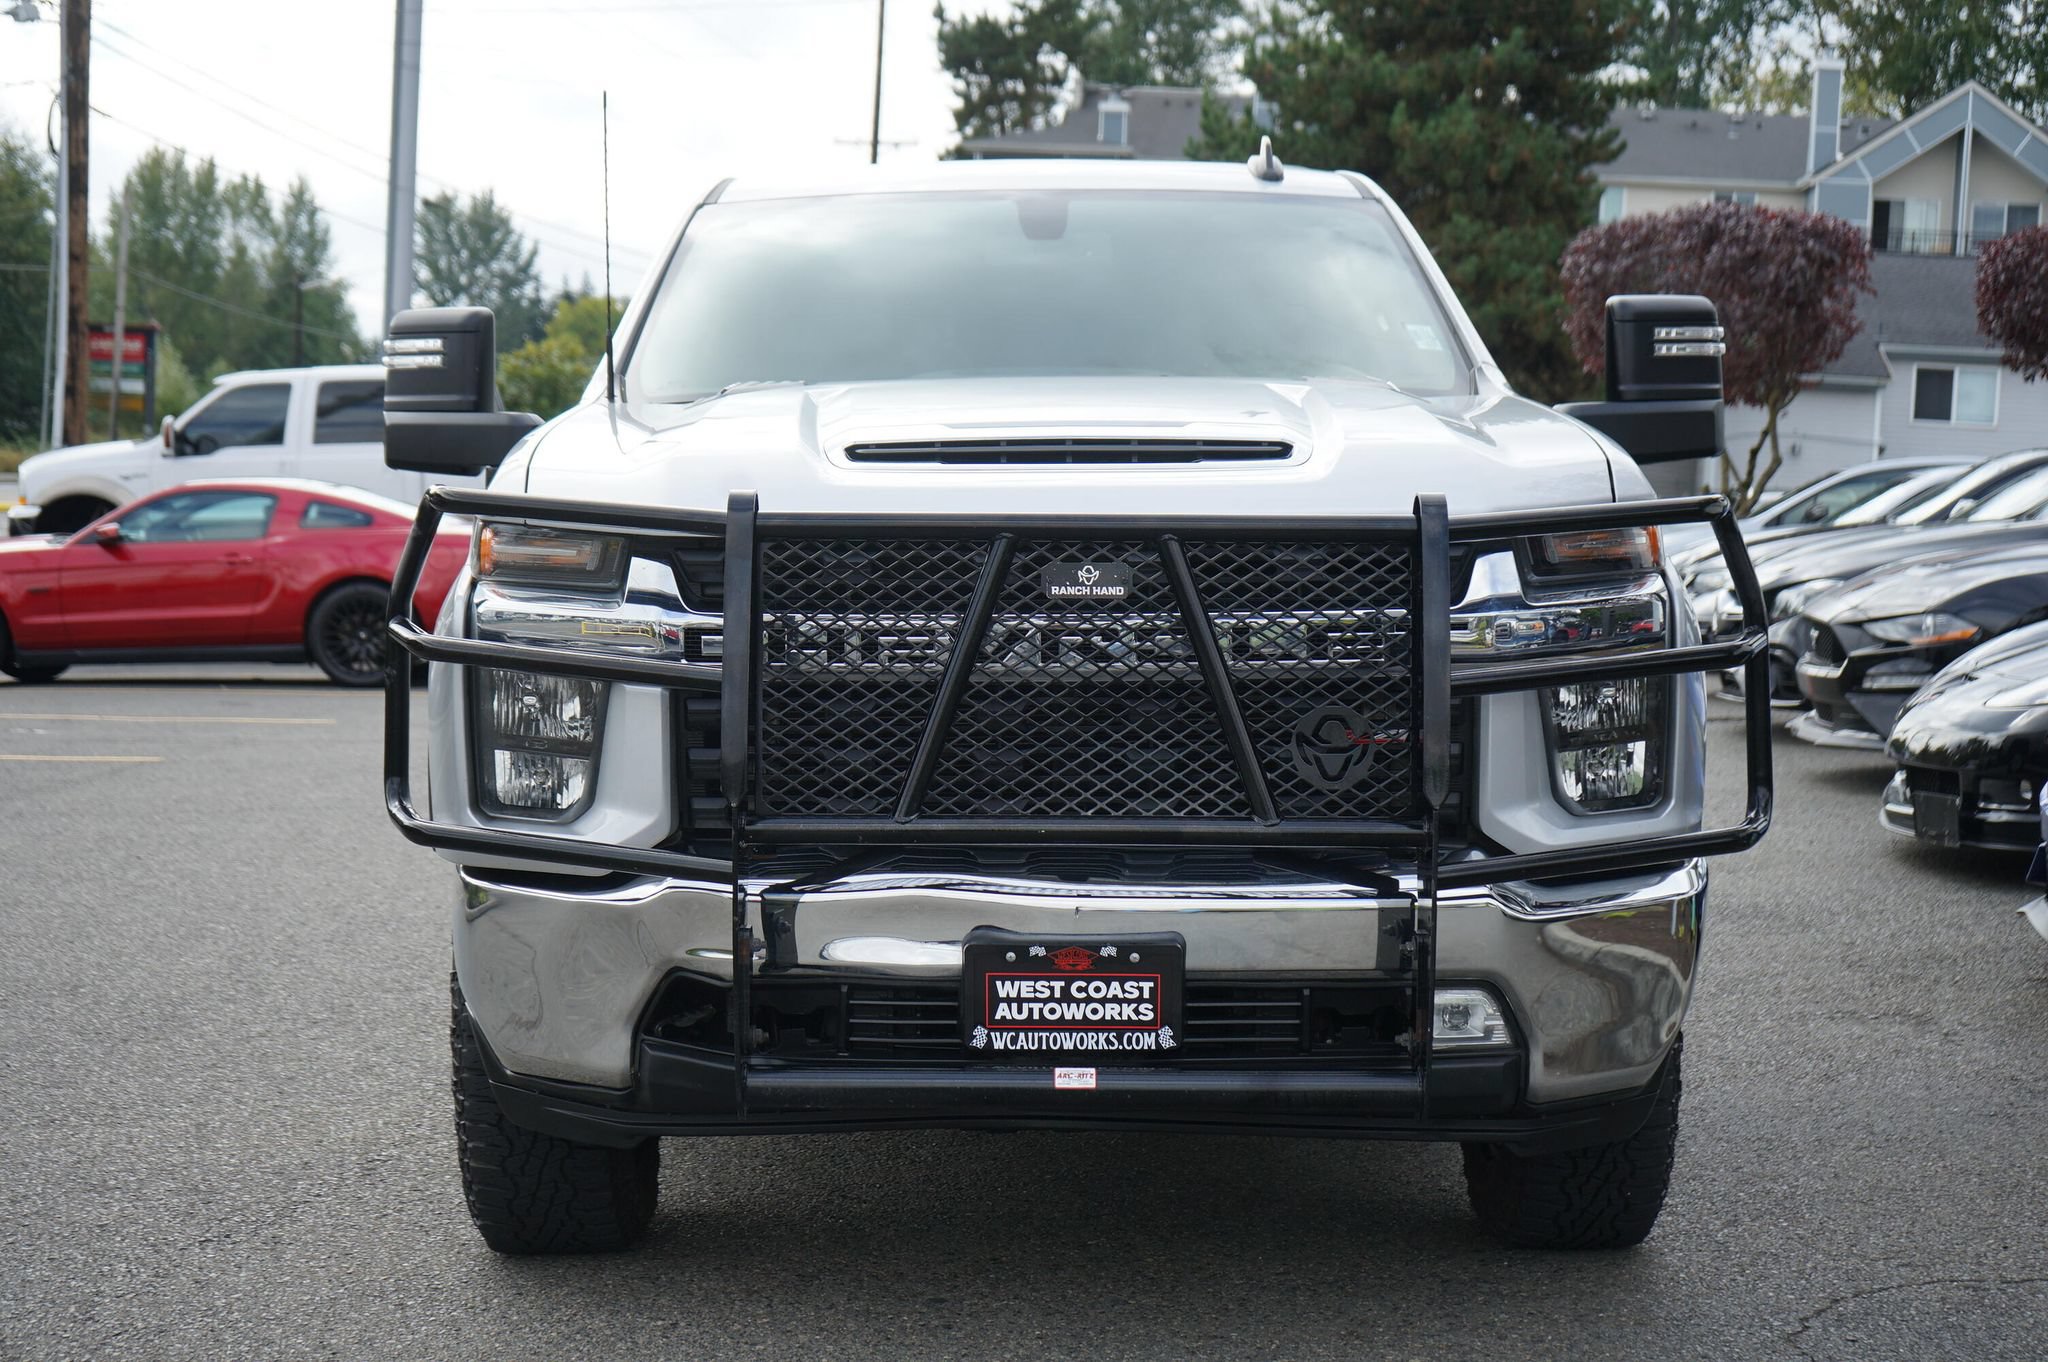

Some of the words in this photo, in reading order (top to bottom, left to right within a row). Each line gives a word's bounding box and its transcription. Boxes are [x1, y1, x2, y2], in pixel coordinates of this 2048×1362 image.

[1051, 586, 1091, 595] RANCH
[1092, 586, 1124, 595] HAND
[995, 980, 1065, 998] WEST
[1070, 981, 1154, 999] COAST
[994, 1002, 1154, 1021] AUTOWORKS
[990, 1031, 1156, 1050] WCAUTOWORKS.COM
